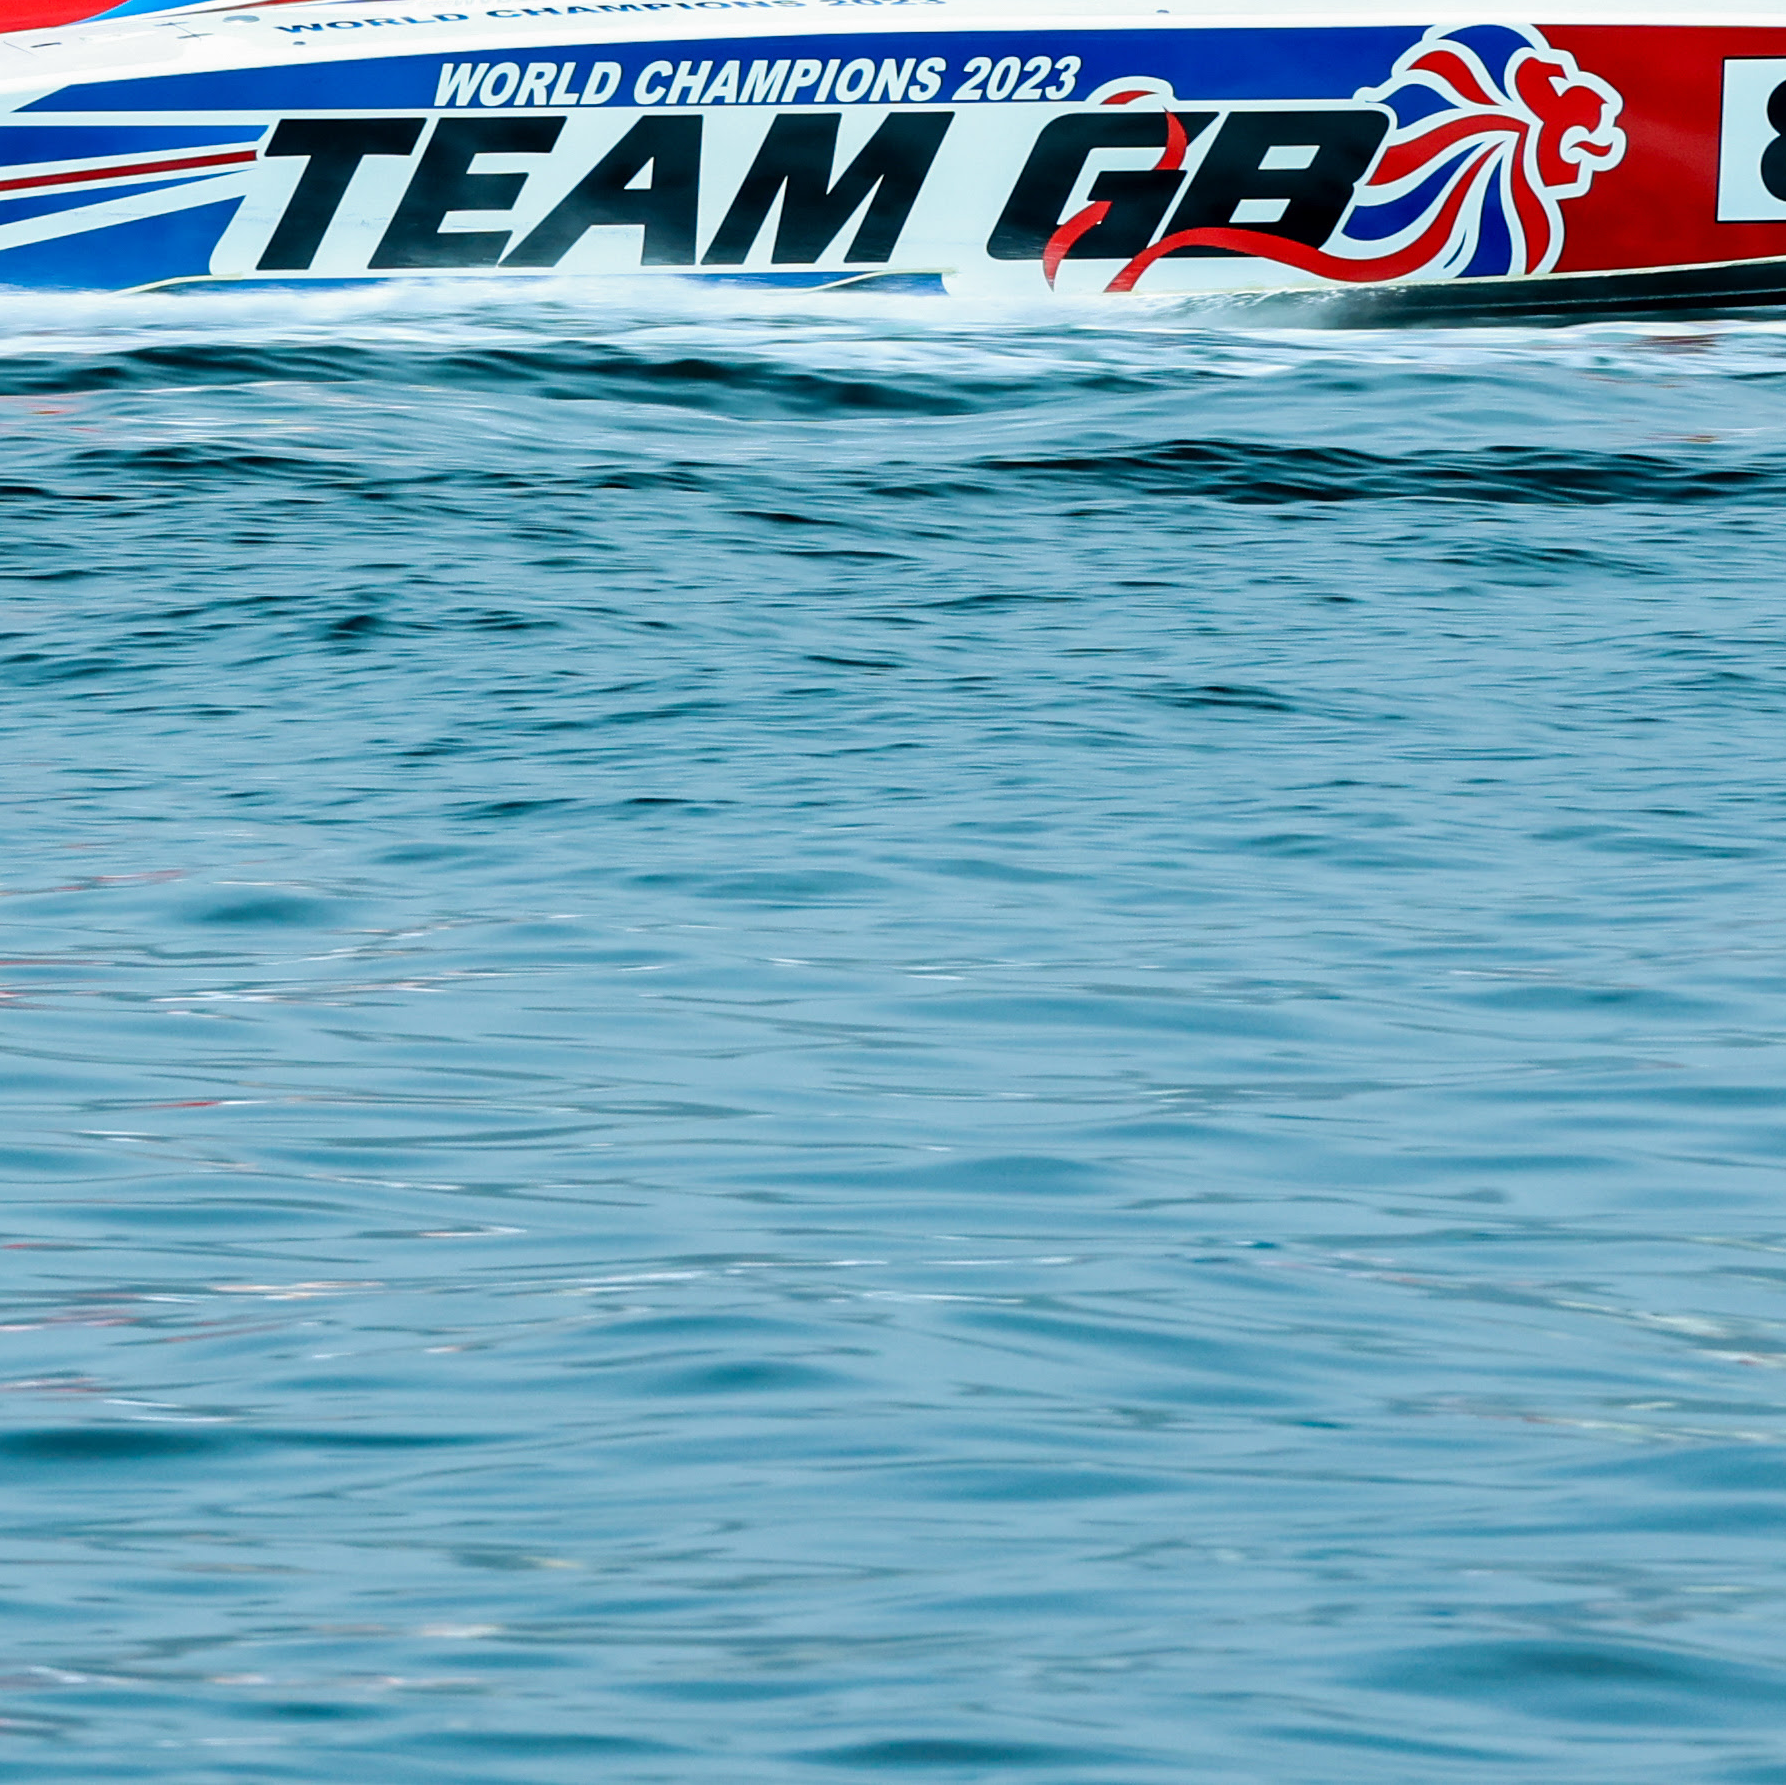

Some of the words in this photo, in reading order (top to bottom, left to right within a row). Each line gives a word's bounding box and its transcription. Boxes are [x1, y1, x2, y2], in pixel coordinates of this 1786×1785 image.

[273, 13, 469, 33] WORLD
[486, 0, 806, 18] CHAMPIONS
[433, 60, 622, 106] WORLD
[633, 57, 944, 104] CHAMPIONS
[952, 56, 1082, 101] 2023
[256, 111, 956, 271] TEAM
[986, 110, 1391, 261] GB
